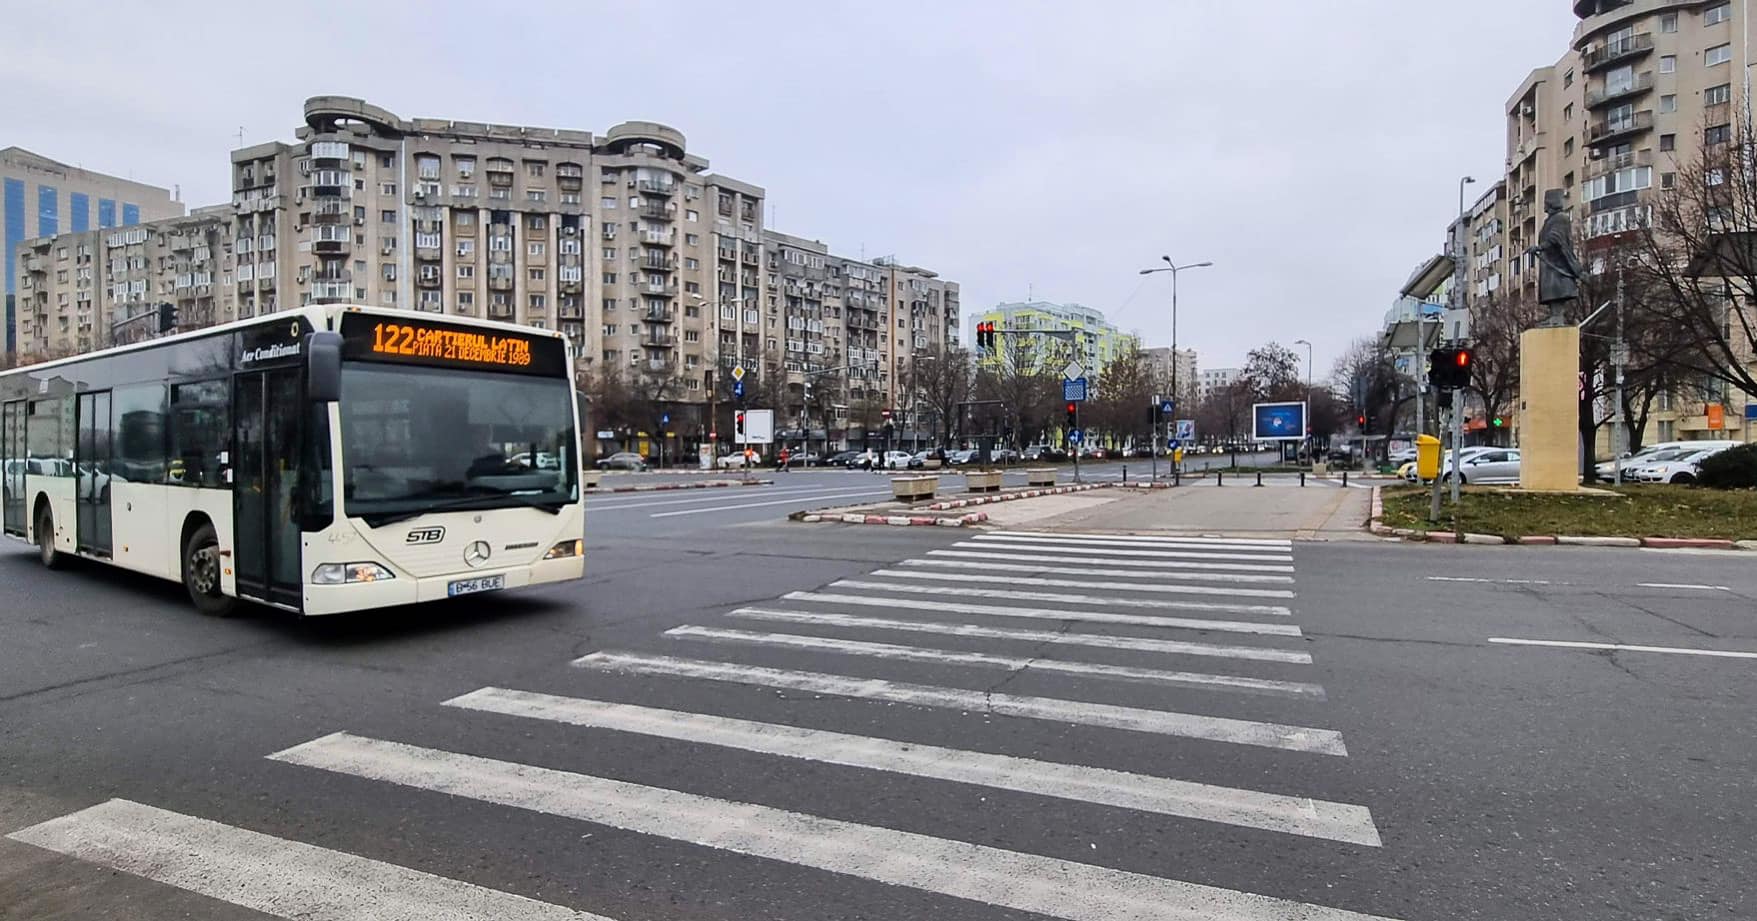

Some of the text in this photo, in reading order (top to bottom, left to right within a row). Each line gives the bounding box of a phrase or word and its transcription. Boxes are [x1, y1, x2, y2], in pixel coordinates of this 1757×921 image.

[374, 323, 414, 354] 122
[417, 328, 529, 352] CARTIERUL LATIN
[413, 340, 531, 366] PIATA 21 DECEMBRIE 1989
[406, 529, 442, 544] STB
[481, 577, 501, 589] BUE
